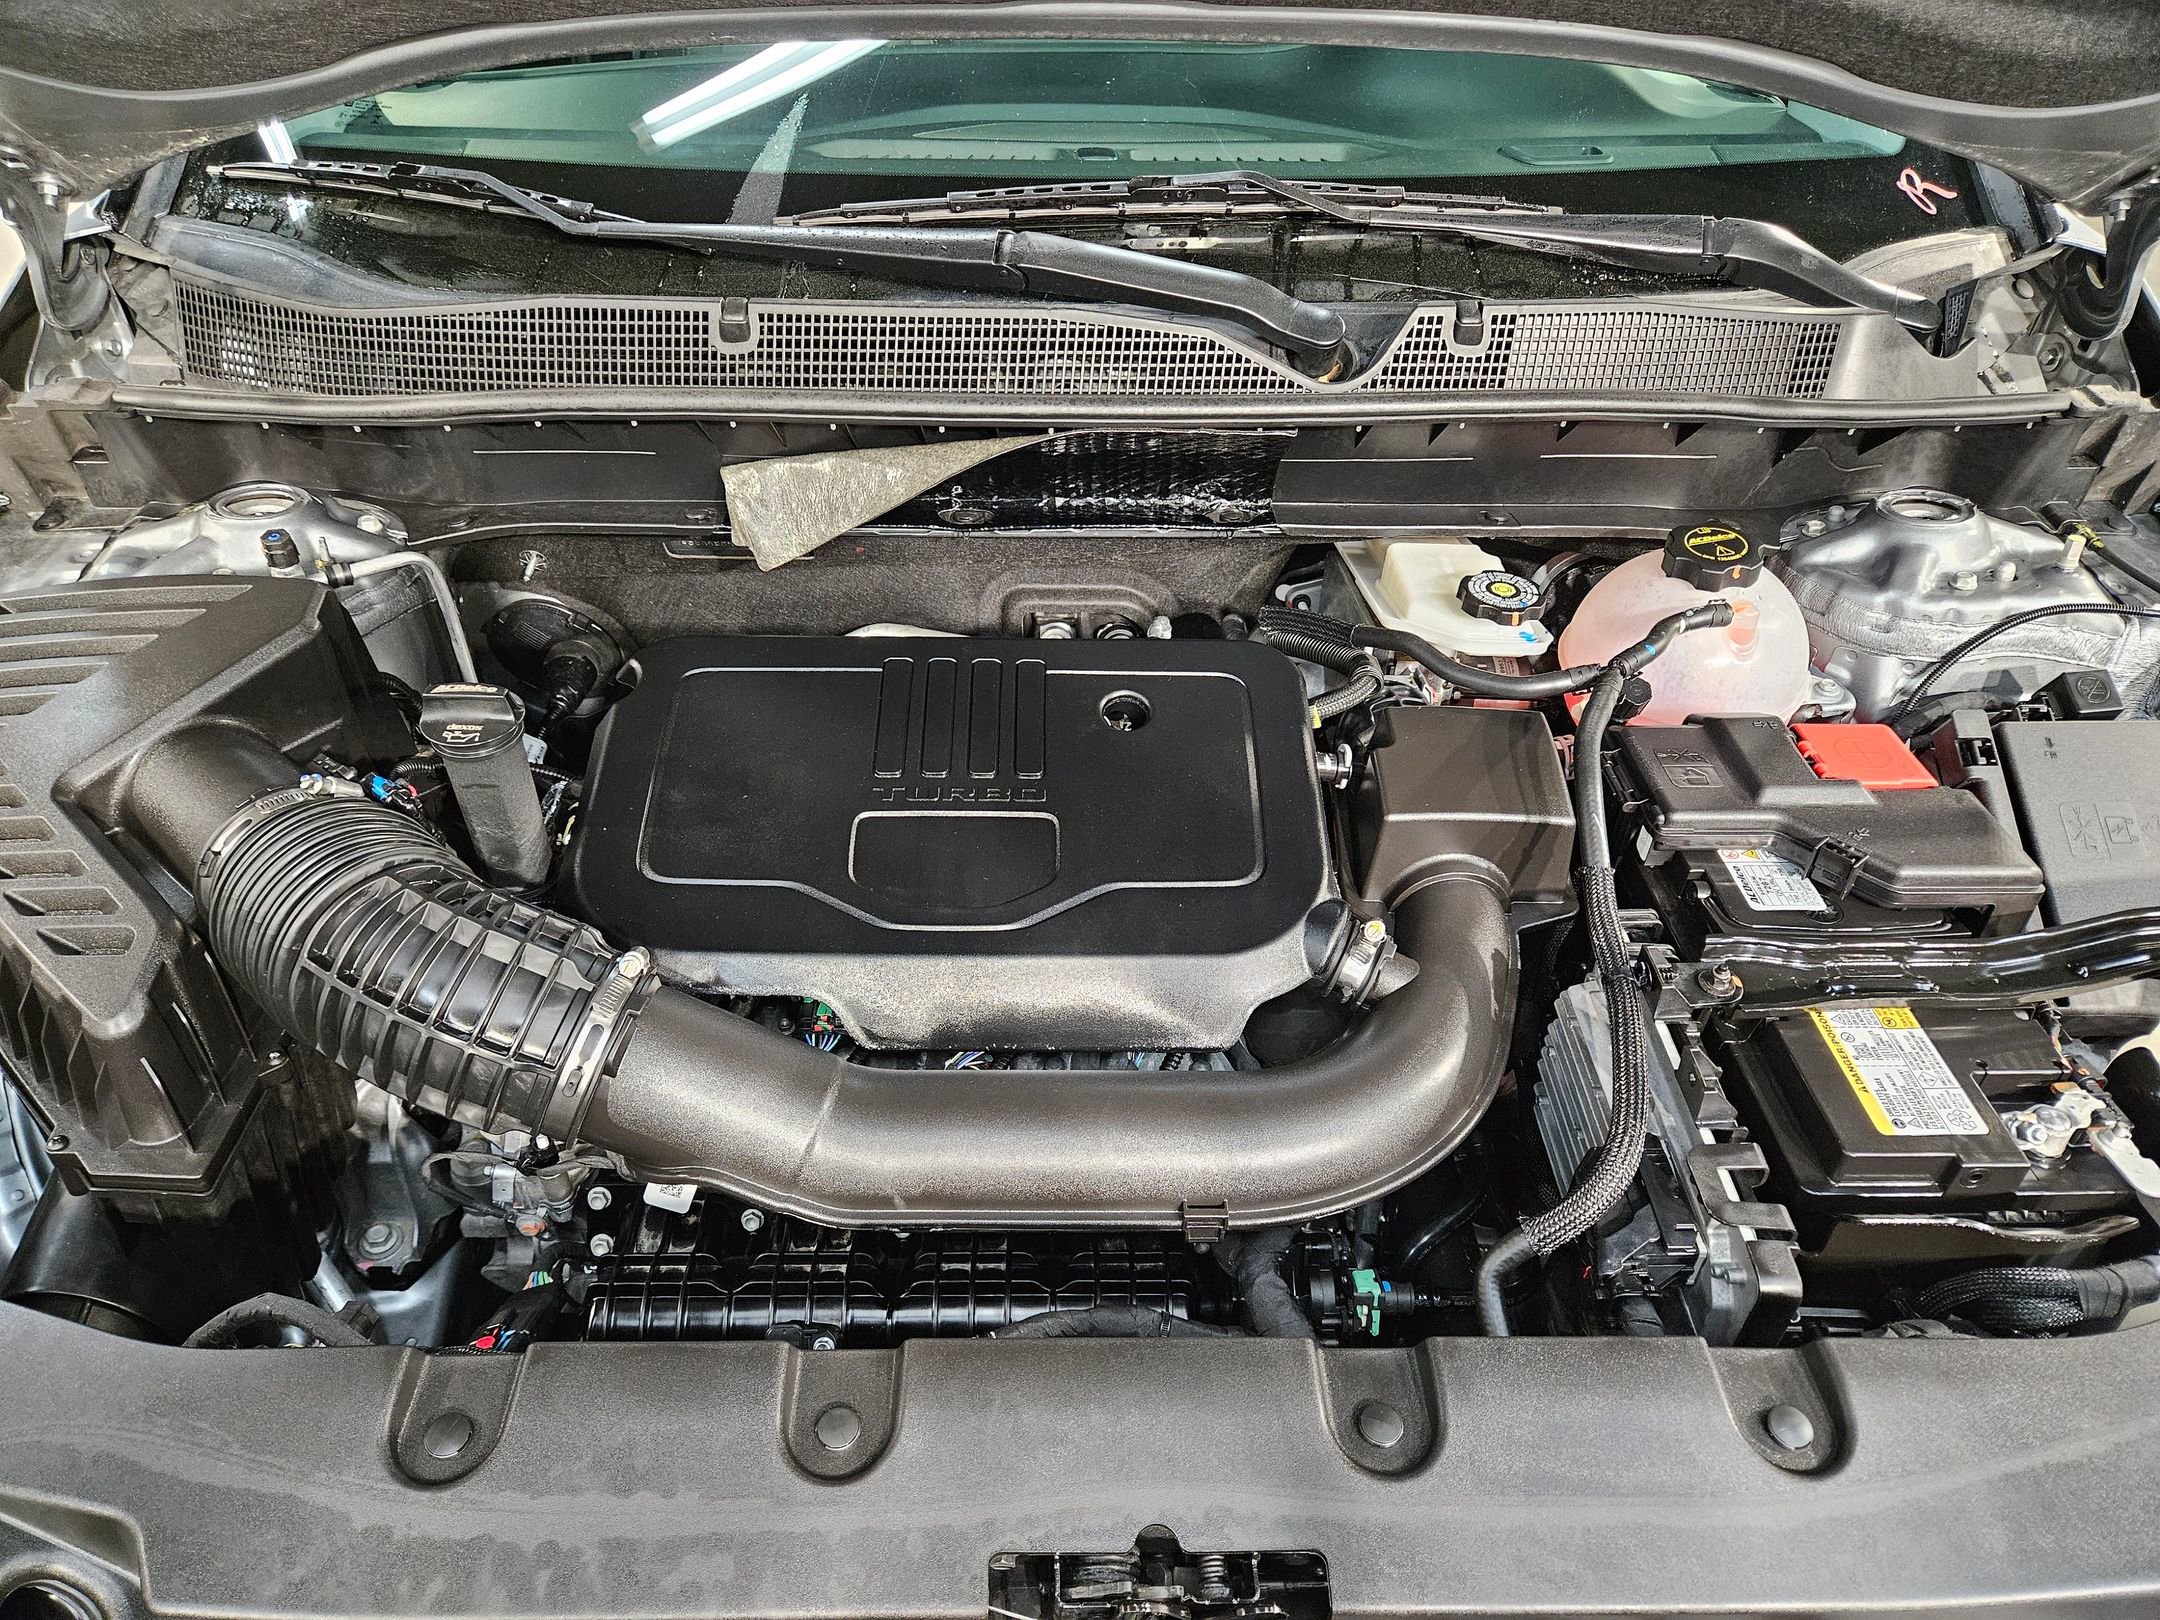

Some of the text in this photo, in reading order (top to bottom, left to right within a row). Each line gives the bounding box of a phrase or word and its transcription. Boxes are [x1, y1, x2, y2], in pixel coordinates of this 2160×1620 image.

[446, 723, 485, 732] dexos
[872, 787, 1047, 802] TURBO
[1732, 865, 1760, 903] ACDelco
